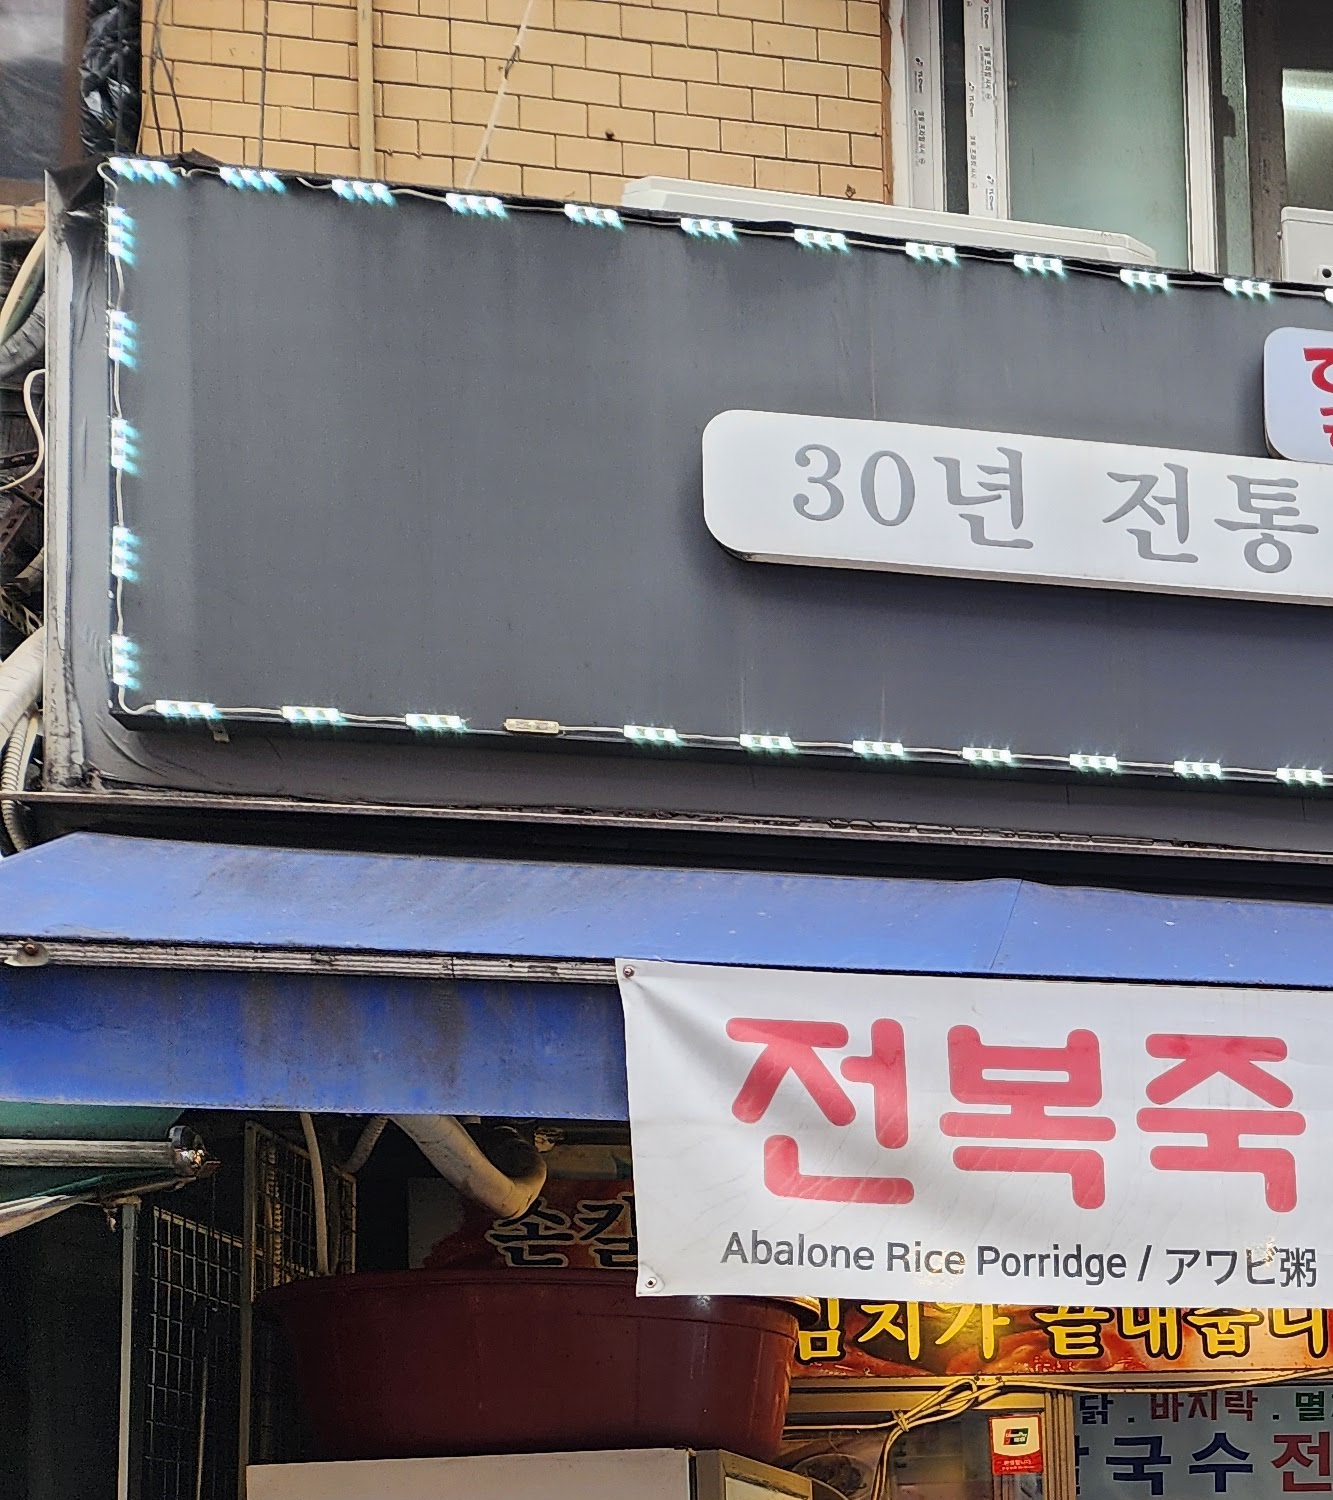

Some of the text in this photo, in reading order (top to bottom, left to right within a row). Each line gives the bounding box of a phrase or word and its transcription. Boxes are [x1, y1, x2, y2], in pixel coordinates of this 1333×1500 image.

[791, 440, 1034, 551] 30년
[1101, 462, 1320, 576] 전통
[725, 1017, 1307, 1214] 전복죽
[723, 1228, 878, 1272] Abalone
[884, 1236, 966, 1276] Rice
[974, 1242, 1129, 1286] Porridge
[1166, 1238, 1319, 1289] アワビ粥
[1152, 1390, 1258, 1422] 바지락
